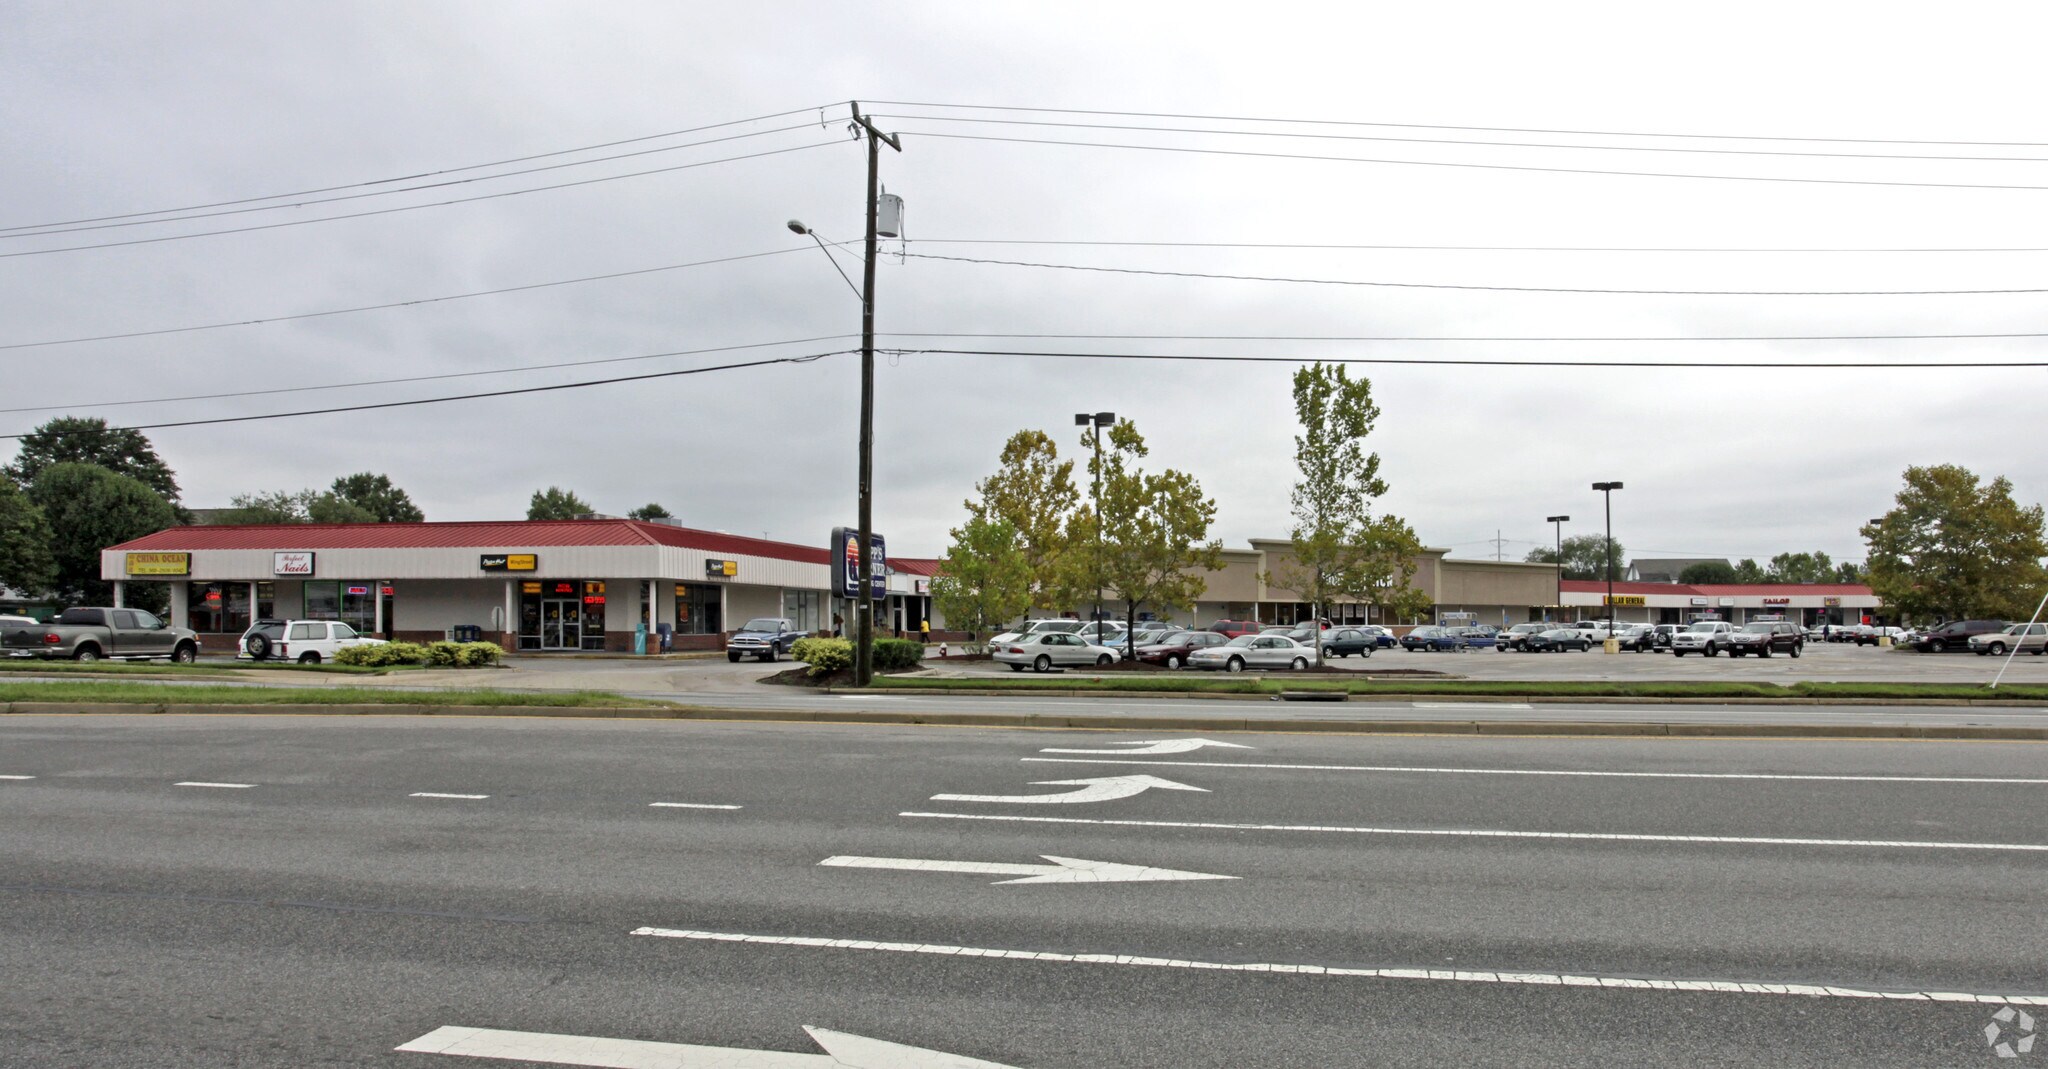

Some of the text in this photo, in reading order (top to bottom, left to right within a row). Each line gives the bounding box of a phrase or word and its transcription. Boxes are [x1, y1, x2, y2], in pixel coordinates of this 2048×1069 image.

[136, 555, 186, 563] CHINA OCEAN
[276, 562, 309, 573] Nails
[870, 562, 886, 577] NER
[1625, 597, 1646, 605] GENERAL
